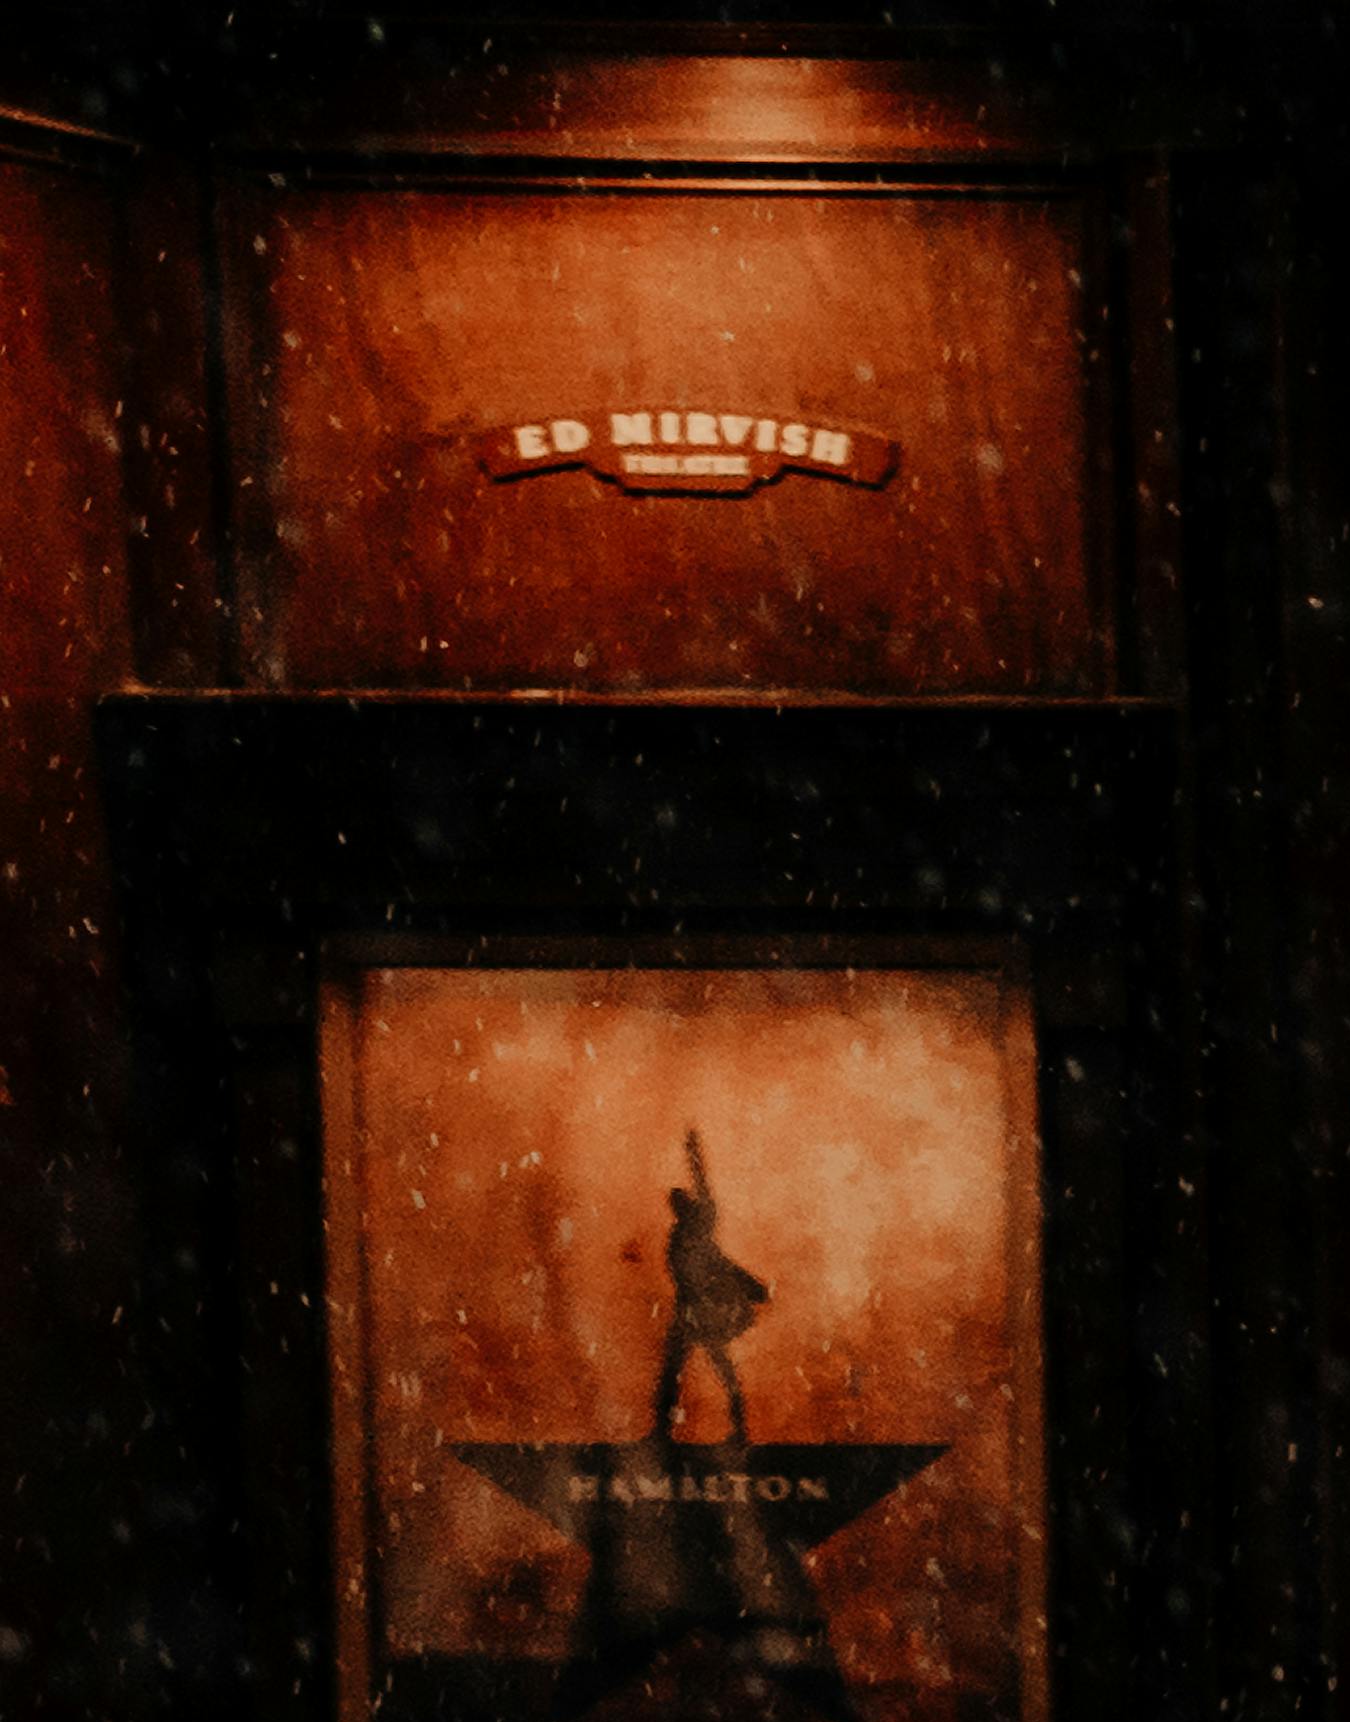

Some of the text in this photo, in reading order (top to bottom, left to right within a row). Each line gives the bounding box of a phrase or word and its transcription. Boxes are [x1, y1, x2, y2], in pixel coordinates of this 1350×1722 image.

[514, 419, 591, 460] ED
[610, 411, 851, 466] MIRVISH
[566, 1472, 830, 1502] HAMILTON
